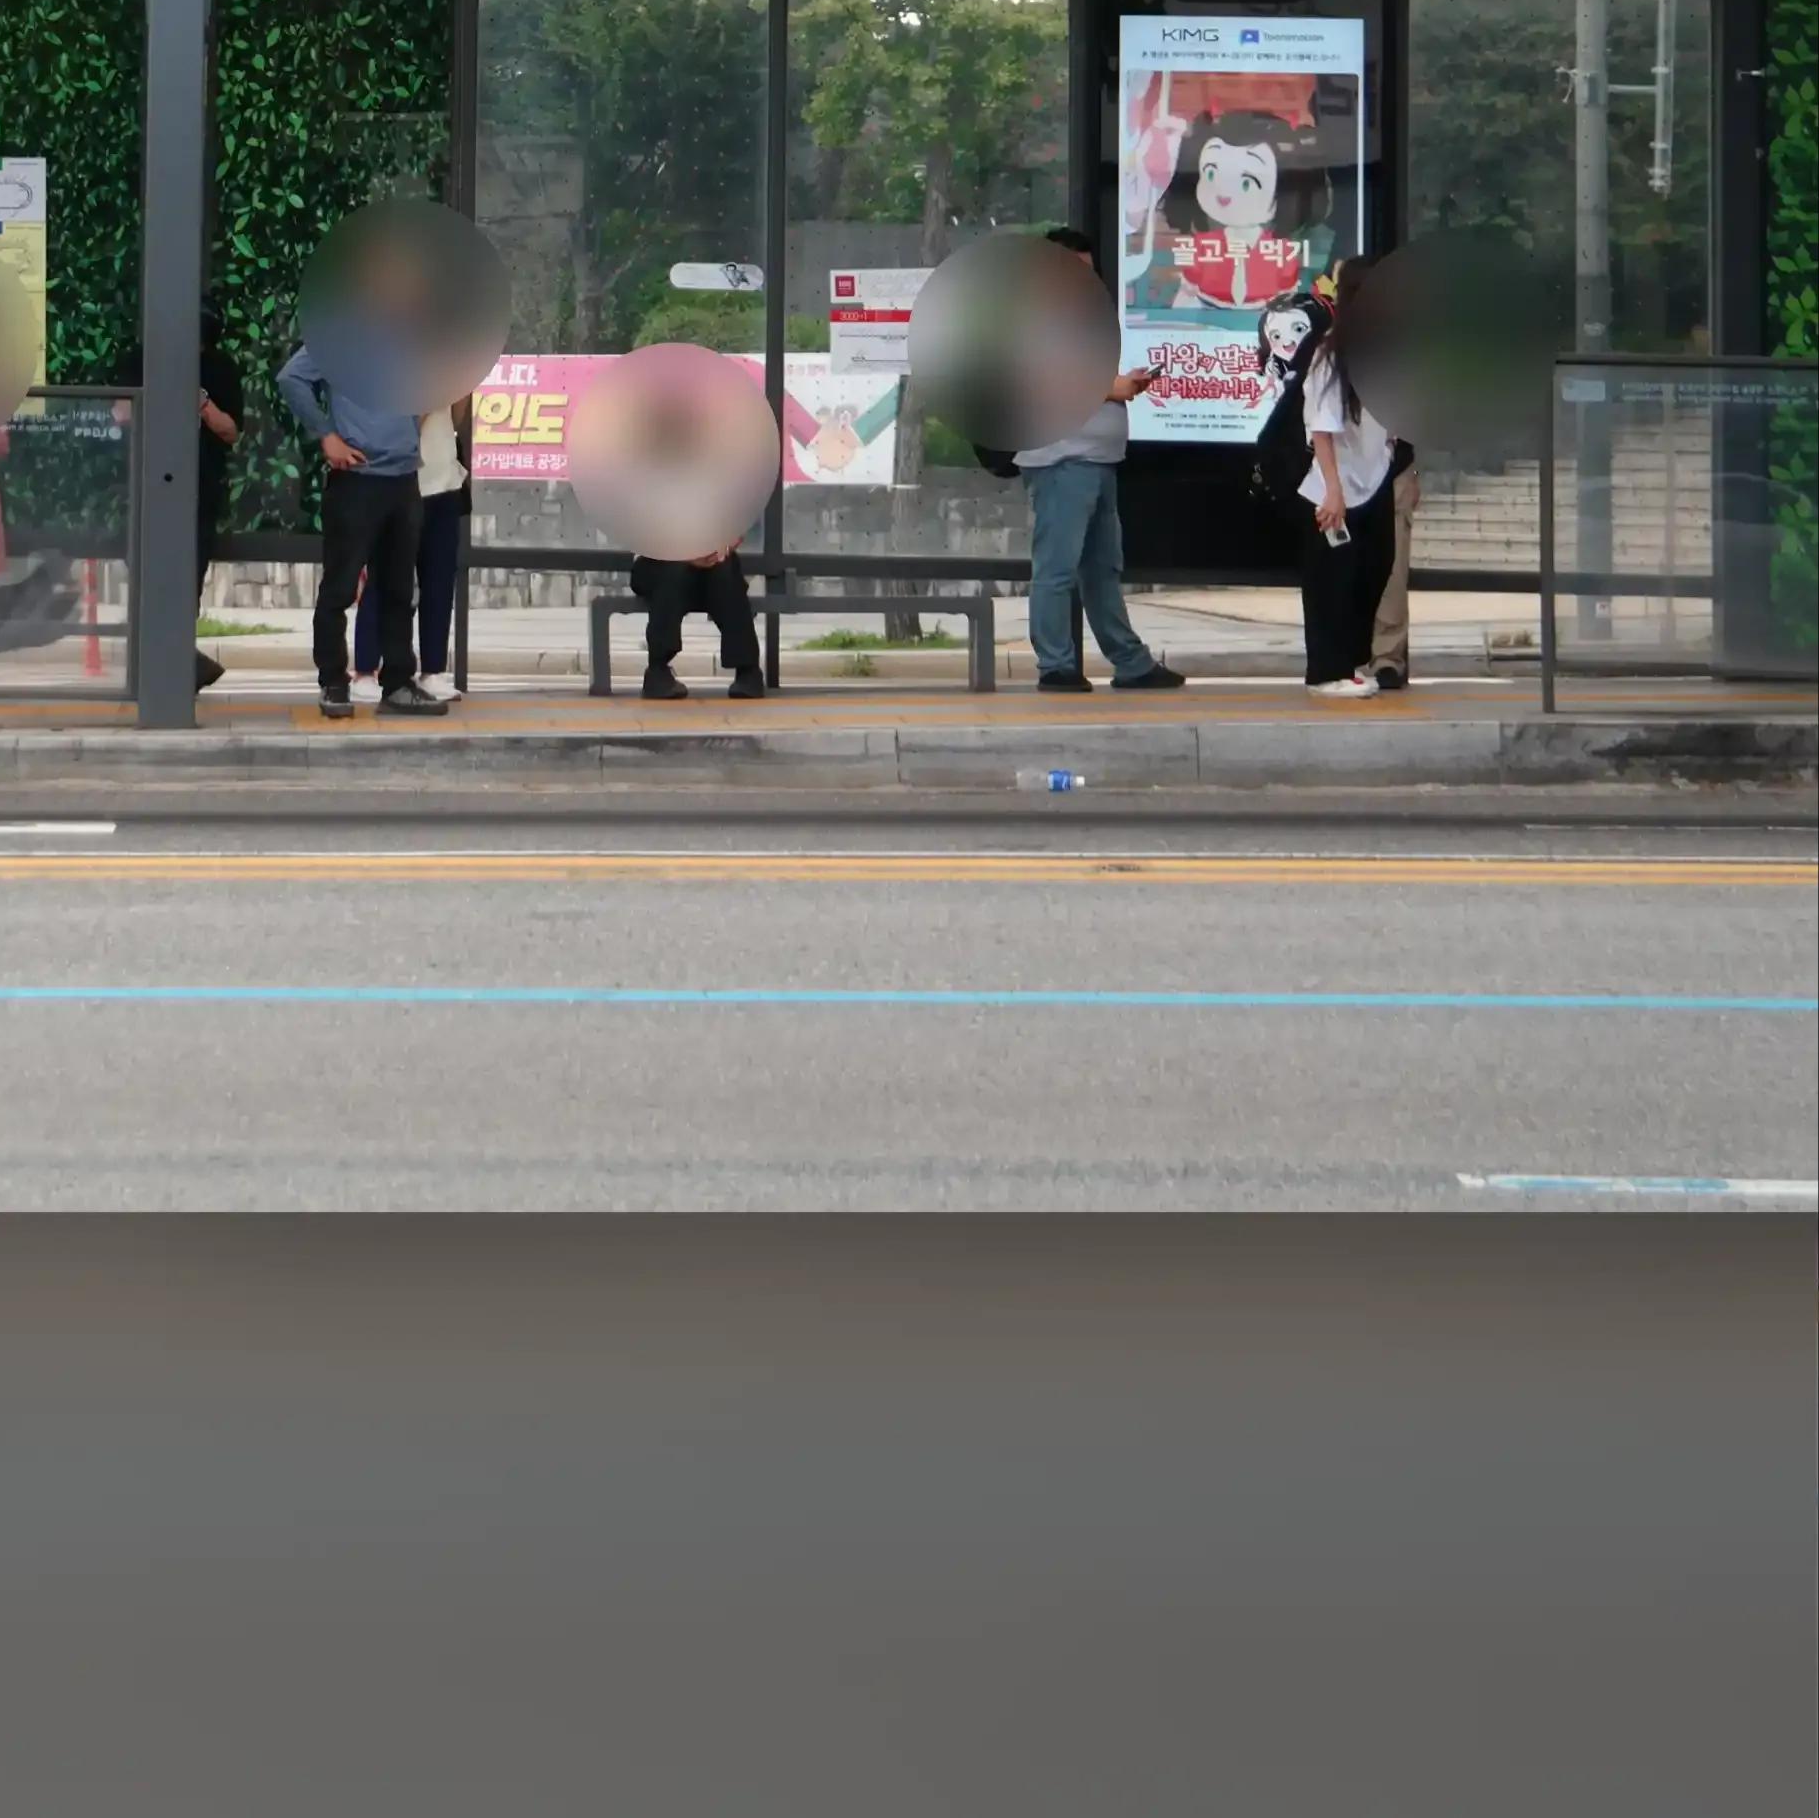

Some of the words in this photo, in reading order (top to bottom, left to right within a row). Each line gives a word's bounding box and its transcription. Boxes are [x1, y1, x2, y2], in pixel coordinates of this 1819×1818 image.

[1162, 28, 1220, 42] KIMG
[1172, 237, 1250, 266] 골고루
[1259, 239, 1310, 268] 먹기
[1147, 342, 1216, 374] 마왕의
